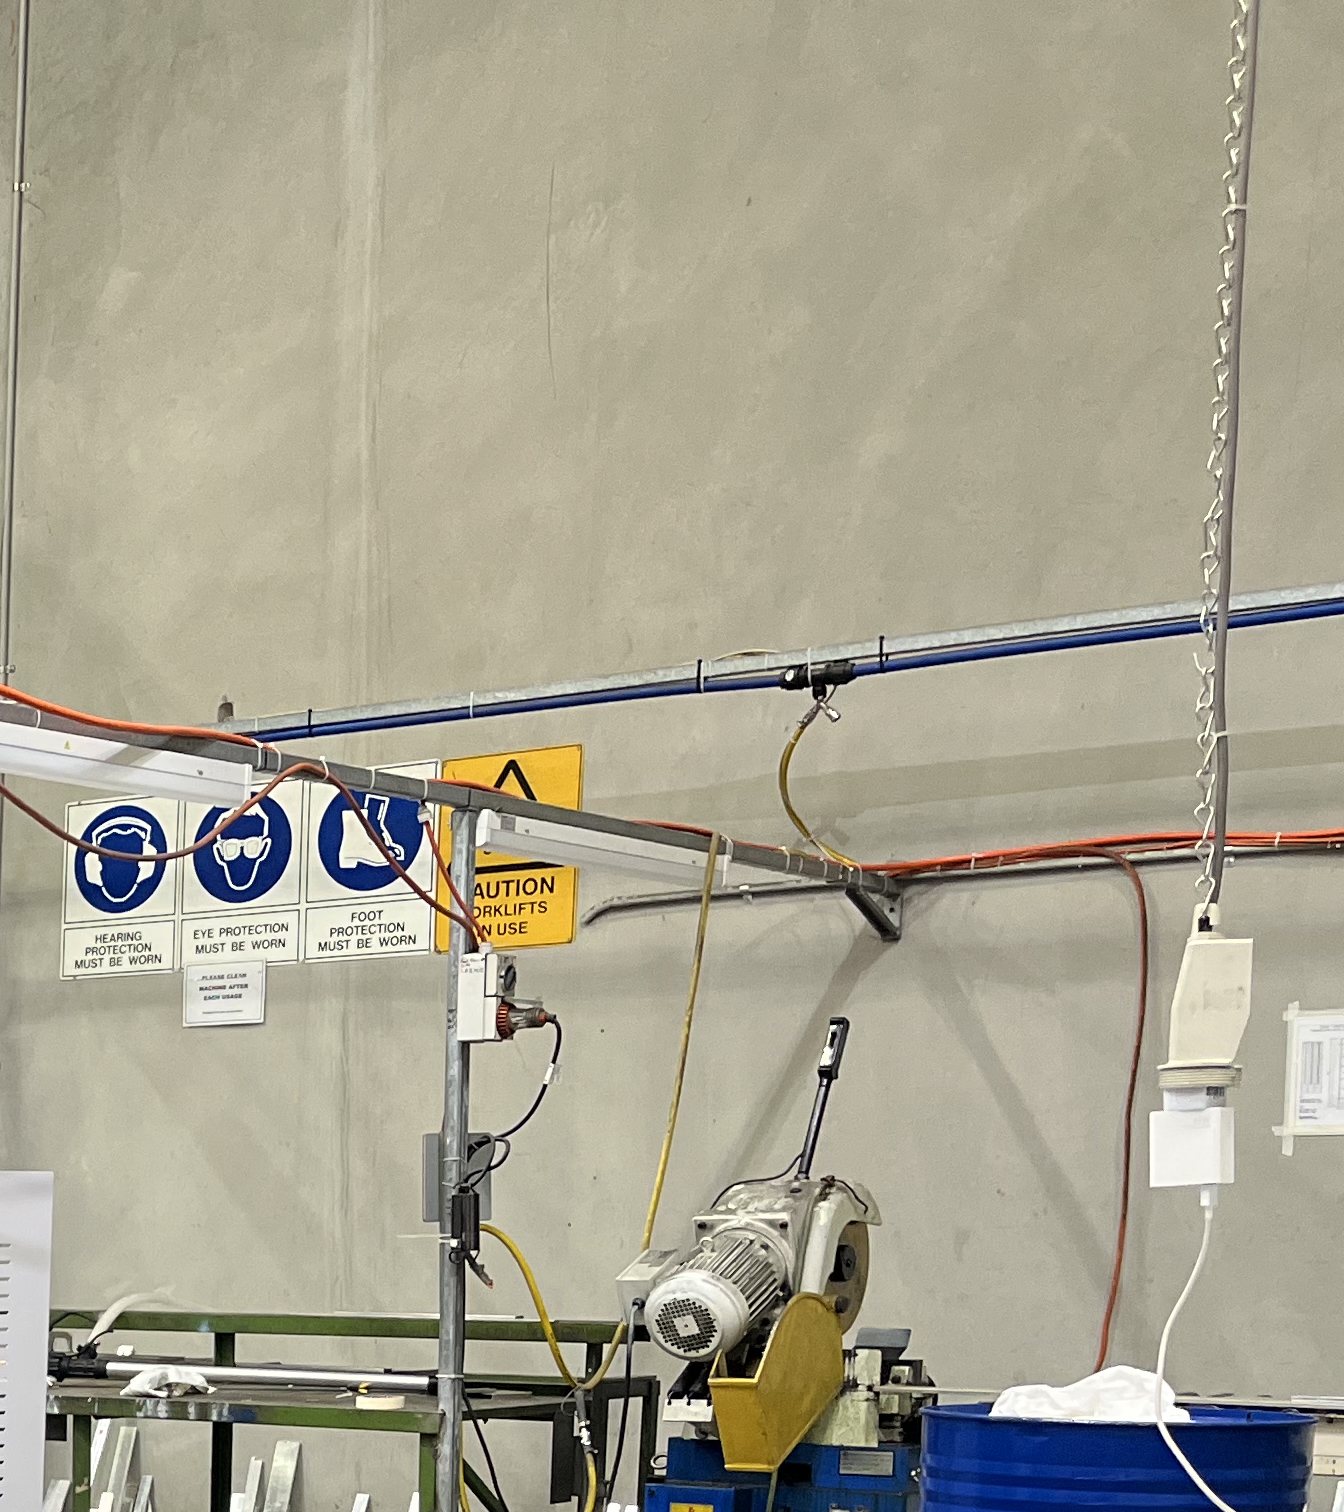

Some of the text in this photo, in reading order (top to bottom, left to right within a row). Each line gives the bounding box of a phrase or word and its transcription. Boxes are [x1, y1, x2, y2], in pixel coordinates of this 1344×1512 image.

[473, 876, 555, 900] AUTION
[350, 910, 384, 923] FOOT
[473, 901, 548, 919] ORKLIFTS
[192, 922, 289, 940] EYE PROTECTION
[329, 922, 406, 938] PROTECTION
[496, 921, 529, 936] USE
[94, 931, 143, 945] HEARING
[317, 934, 417, 952] MUST BE WORN
[84, 942, 152, 956] PROTECTION
[194, 938, 286, 955] MUST BE WORN
[74, 954, 163, 969] MUST BE WORN
